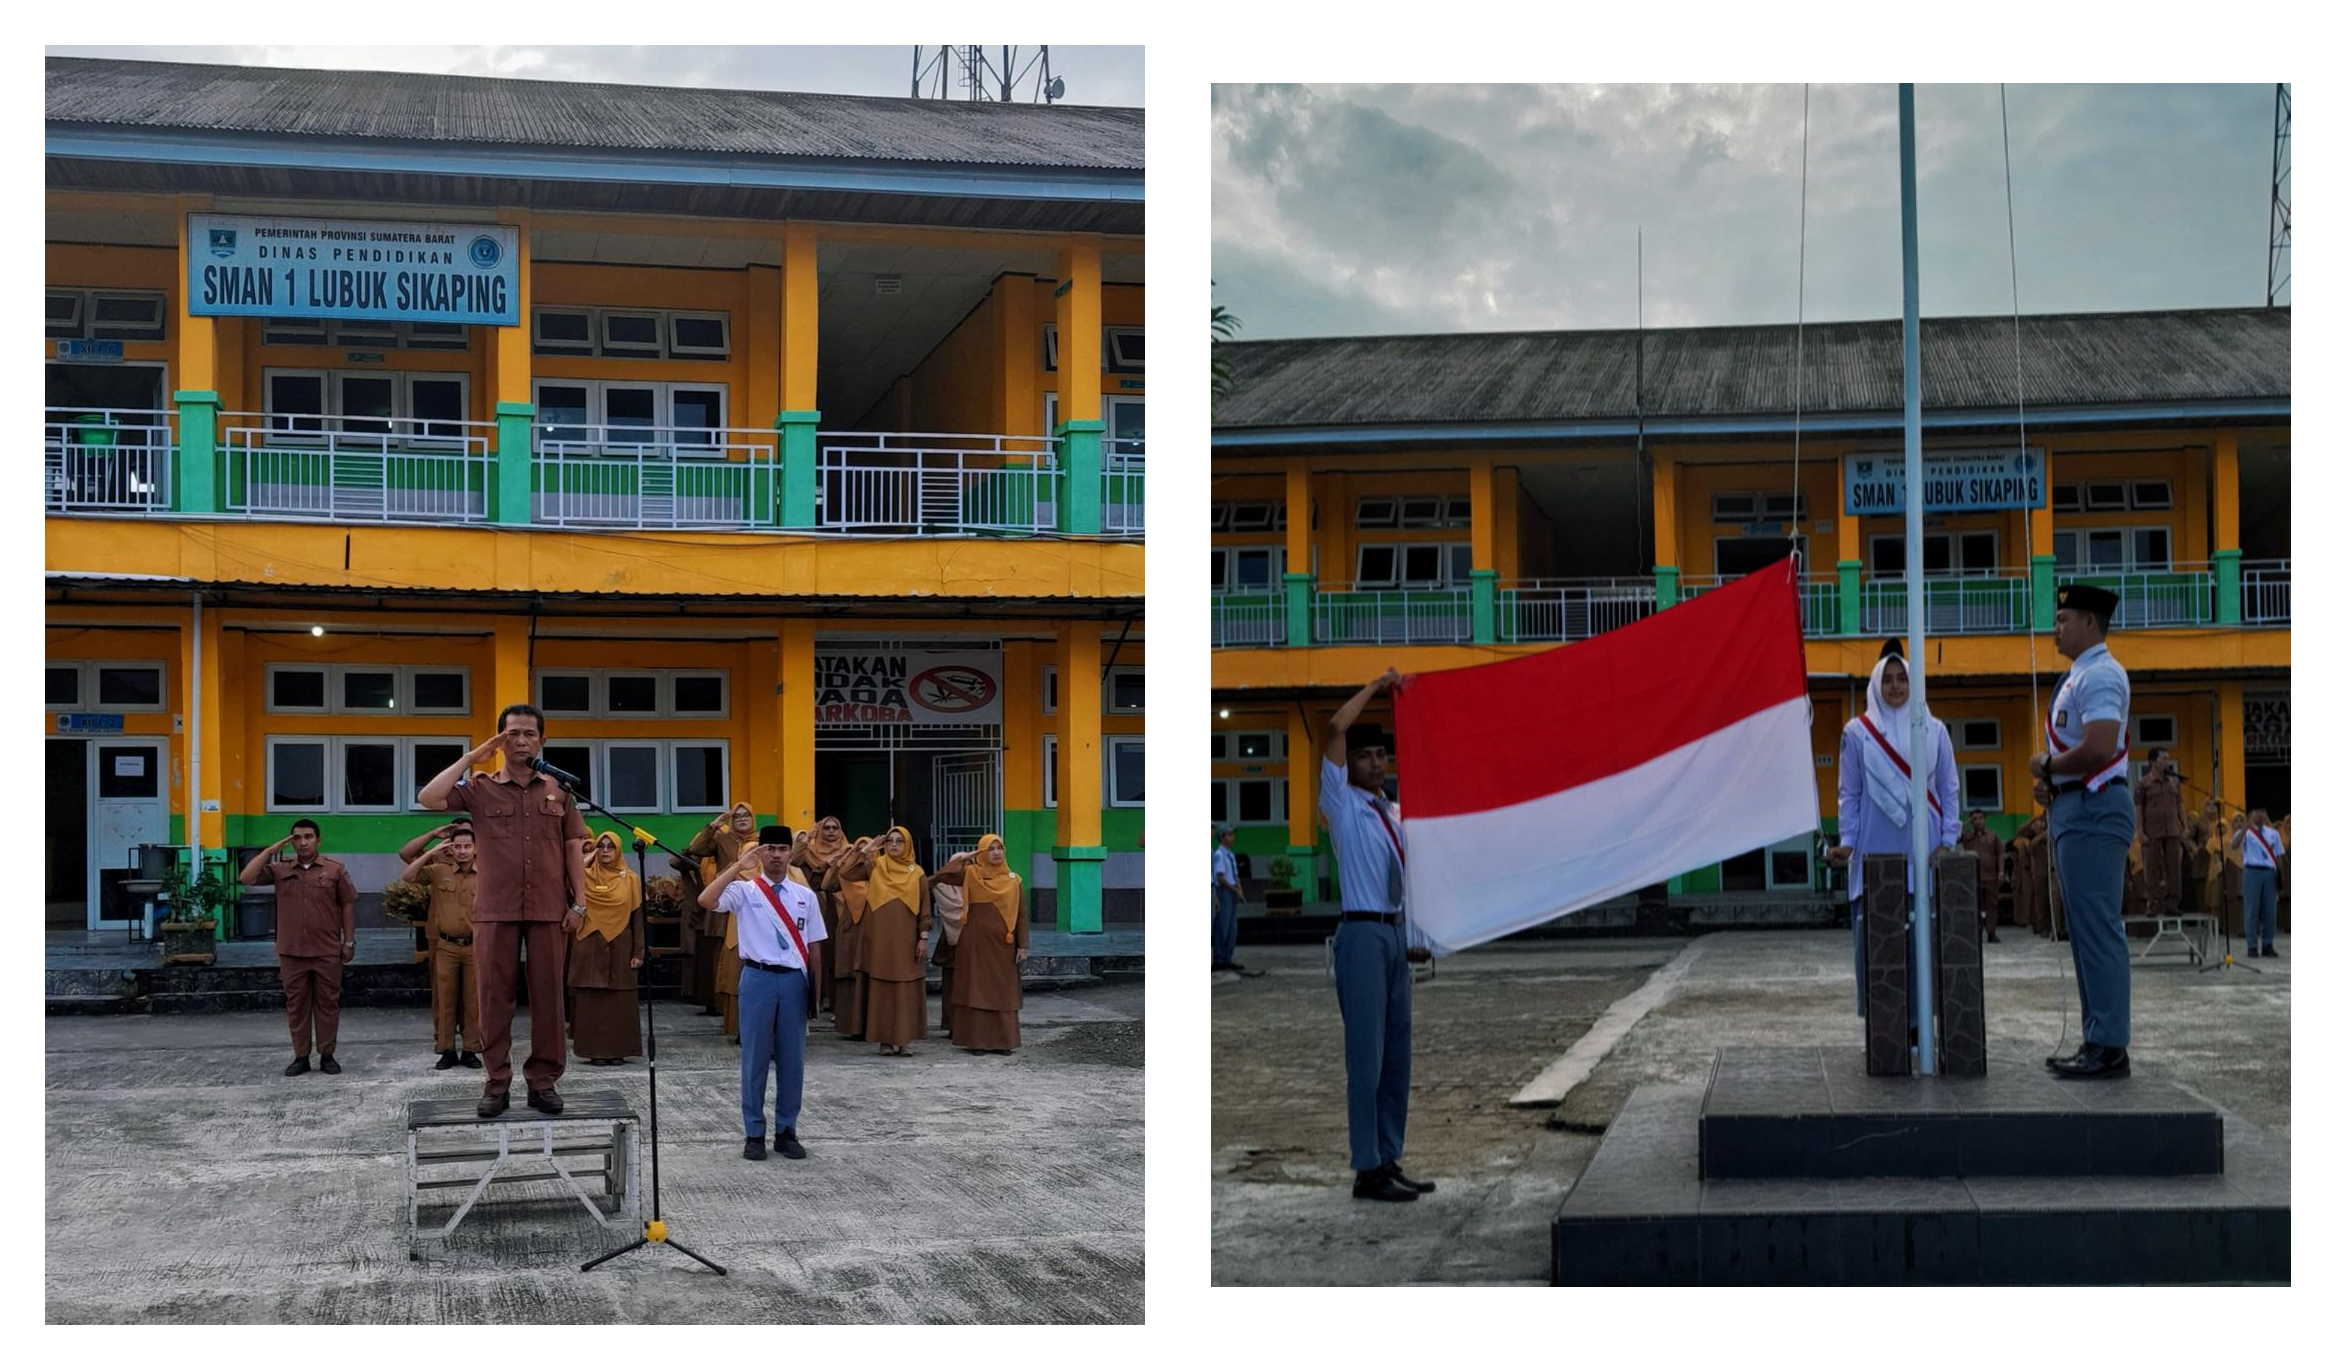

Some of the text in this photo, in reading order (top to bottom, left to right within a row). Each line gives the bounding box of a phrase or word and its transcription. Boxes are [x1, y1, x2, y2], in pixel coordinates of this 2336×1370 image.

[254, 227, 456, 245] PEMERINTAH PROVINSI SUMATERA BARAT
[258, 245, 453, 265] DINAS PENDIDIKAN
[203, 264, 507, 315] SMAN 1 LUBUK SIKAPING
[1930, 465, 2005, 476] PENDIDIKAN
[1853, 482, 1895, 508] SMAN
[1924, 479, 1965, 505] UBUK
[1969, 477, 2038, 504] SIKAPING
[814, 656, 906, 678] ATAKAN
[814, 671, 905, 688] IDAK
[814, 688, 909, 709] ADA
[814, 703, 914, 722] ARKOBA
